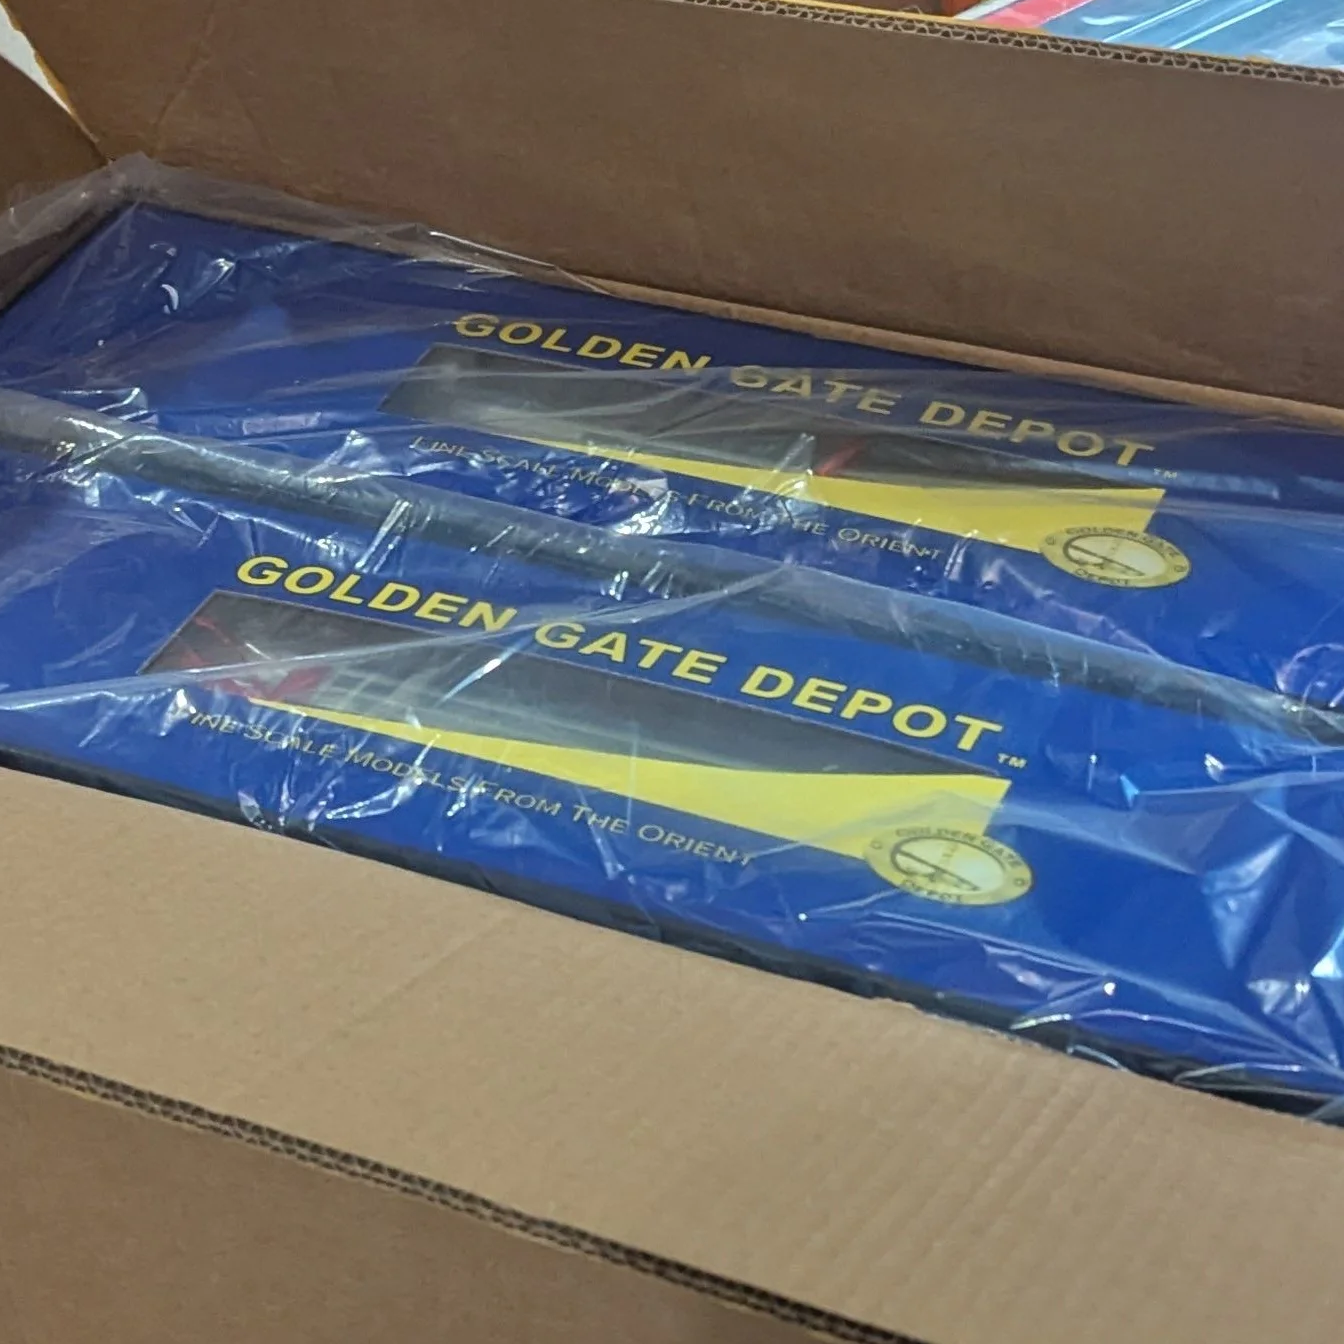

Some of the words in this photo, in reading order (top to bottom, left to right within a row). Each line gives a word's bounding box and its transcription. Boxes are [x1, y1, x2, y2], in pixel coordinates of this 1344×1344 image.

[456, 313, 712, 375] GOLDEN
[729, 364, 903, 416] GATE
[918, 399, 1156, 467] DEPOT
[838, 527, 944, 561] ORIENT
[236, 555, 518, 633] GOLDEN
[534, 621, 728, 685] GATE
[739, 664, 1004, 753] DEPOT
[186, 708, 239, 734] INE
[571, 804, 631, 834] THE
[638, 824, 753, 867] ORIENT
